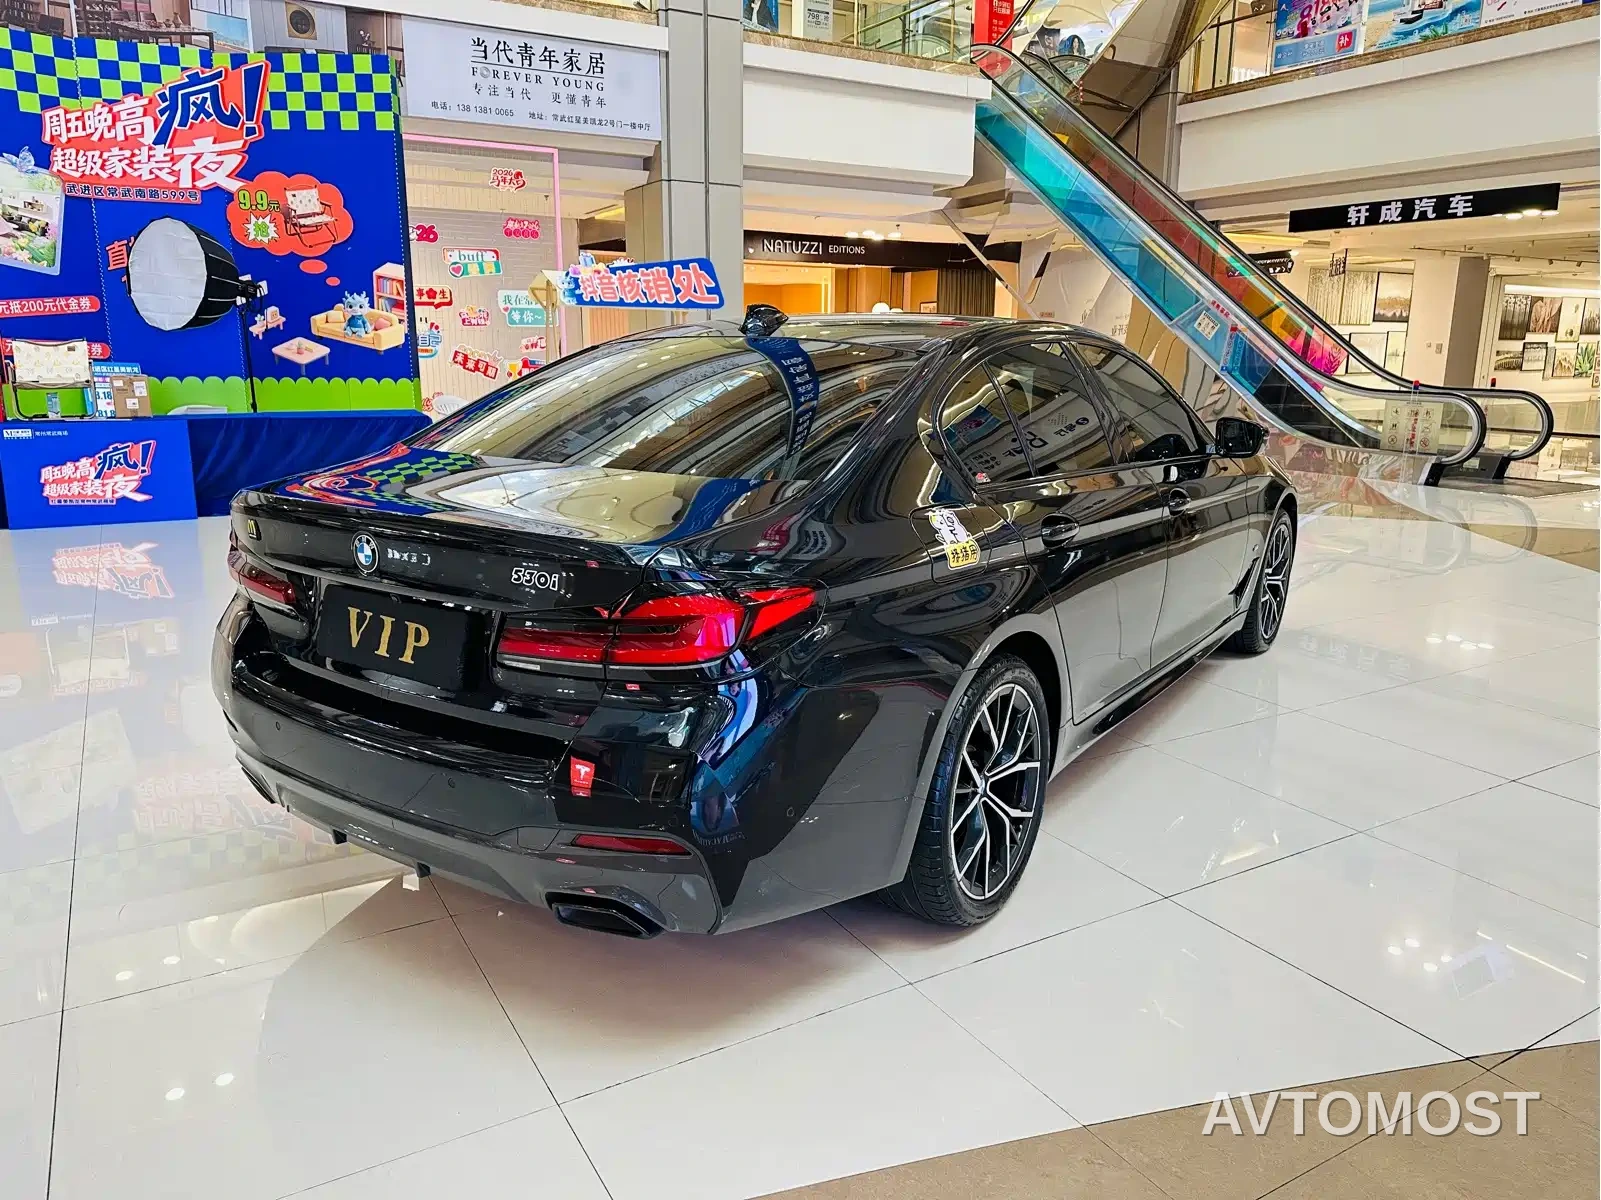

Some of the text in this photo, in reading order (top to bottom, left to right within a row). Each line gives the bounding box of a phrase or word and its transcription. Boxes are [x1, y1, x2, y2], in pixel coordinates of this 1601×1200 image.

[471, 36, 605, 75] 当代青年家居
[472, 66, 605, 92] FOREVER YOUNG
[473, 83, 607, 108] 专注当代 更懂青年
[457, 103, 471, 112] 138
[474, 105, 492, 115] 1381
[495, 107, 514, 117] 0065
[52, 137, 250, 192] 超级家装夜
[492, 168, 513, 177] 2026
[66, 183, 200, 202] 武进区常武南路599号
[1347, 194, 1474, 227] 轩成汽车
[253, 221, 270, 237] 抢
[458, 250, 485, 262] buff
[762, 238, 866, 255] NATUZZI EDITIONS
[580, 262, 720, 304] 抖音核销处
[453, 350, 499, 380] 未来可期
[511, 567, 560, 591] 530i
[347, 606, 430, 665] VIP
